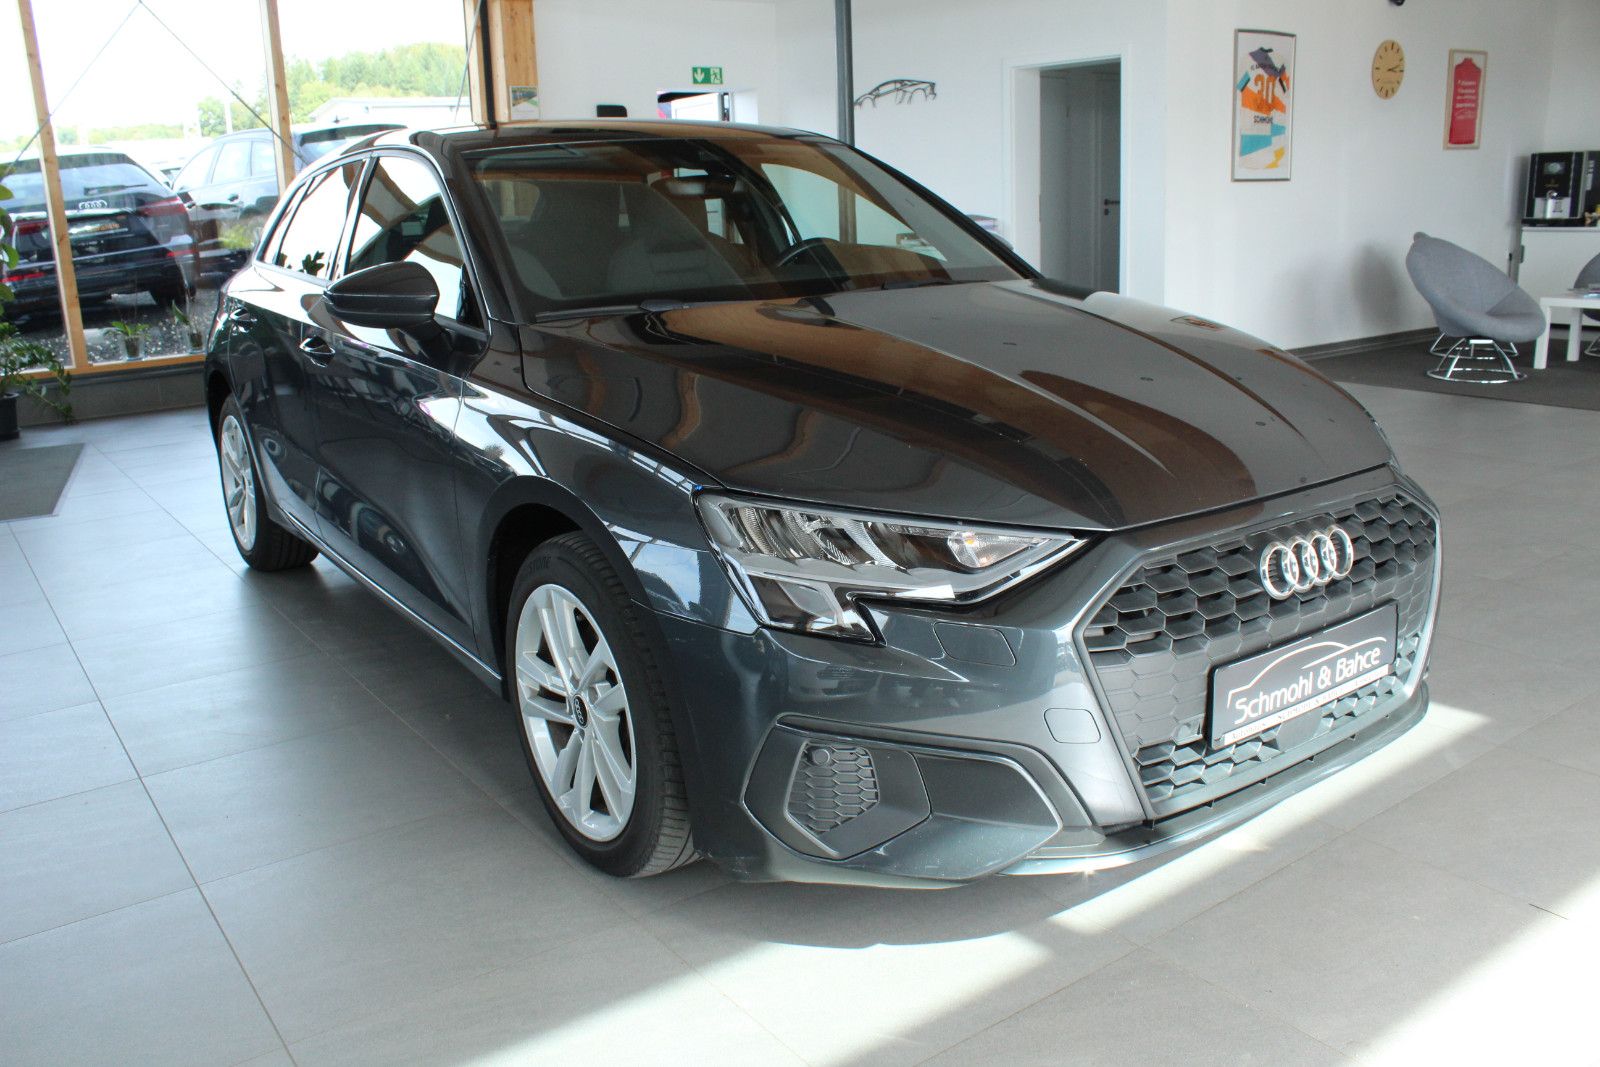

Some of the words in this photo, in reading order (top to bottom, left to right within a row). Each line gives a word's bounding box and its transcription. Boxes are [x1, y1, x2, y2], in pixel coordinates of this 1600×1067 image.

[1234, 671, 1314, 725] Schmohl
[1317, 665, 1332, 690] &
[1335, 647, 1381, 683] Bahce
